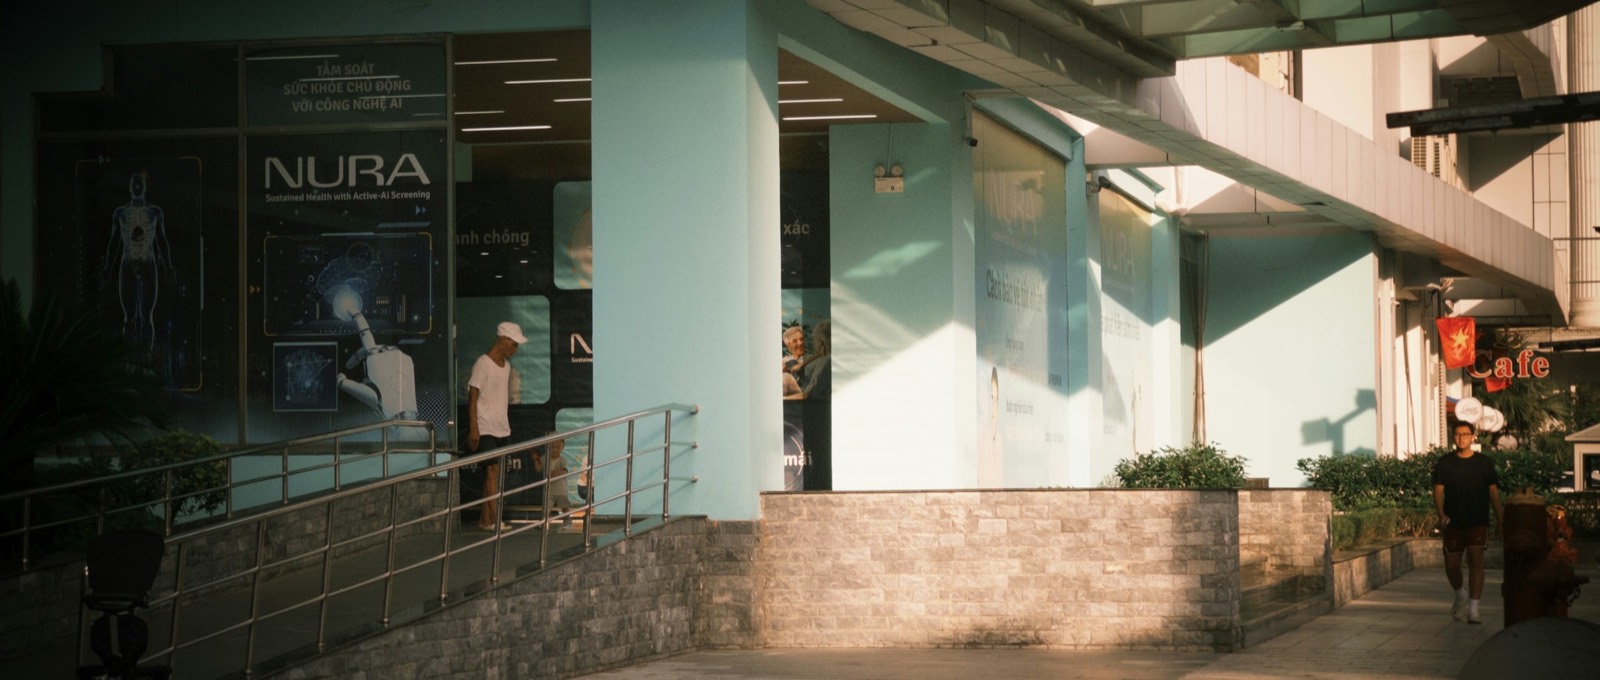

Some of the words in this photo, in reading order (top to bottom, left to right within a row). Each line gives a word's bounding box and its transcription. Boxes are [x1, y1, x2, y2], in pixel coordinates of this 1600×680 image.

[344, 61, 375, 75] SOÁT
[283, 80, 308, 95] SỨC
[311, 79, 343, 94] KHỎE
[375, 79, 411, 94] ĐỘNG
[292, 98, 312, 112] VỚI
[316, 98, 350, 111] CÔNG
[353, 97, 387, 112] NGHỆ
[390, 97, 402, 109] AI
[264, 153, 431, 189] NURA
[265, 193, 304, 202] Sustained
[306, 192, 332, 201] Health
[334, 192, 351, 200] with
[353, 191, 390, 200] Active-Ai
[391, 190, 431, 201] Screening
[783, 217, 810, 235] xác
[455, 229, 479, 245] anh
[483, 228, 529, 247] chóng
[1465, 349, 1550, 379] Cafe
[783, 450, 812, 467] mái
